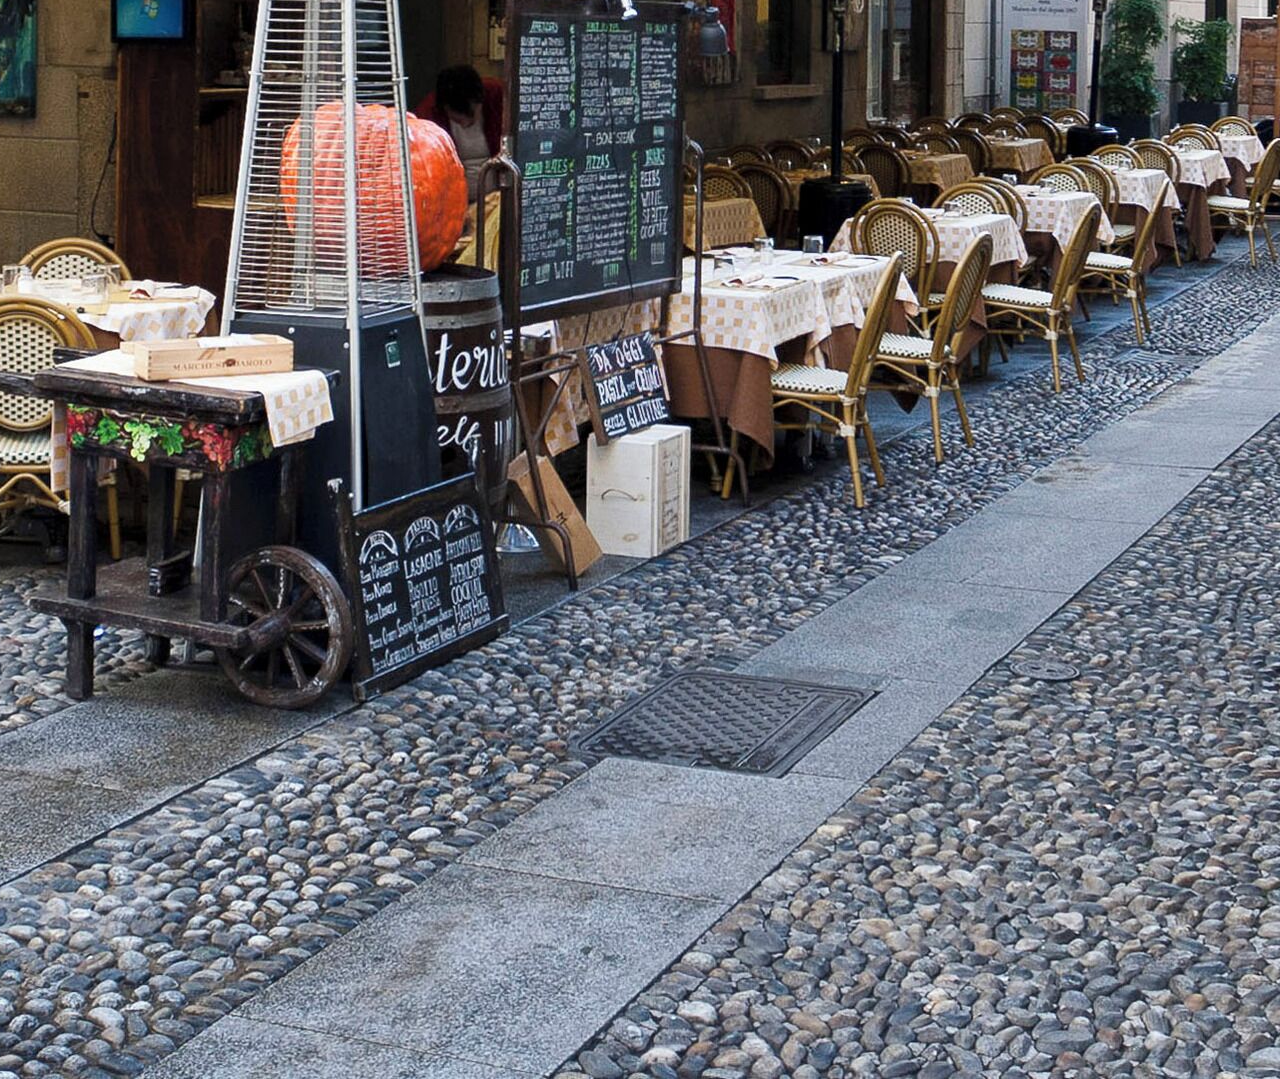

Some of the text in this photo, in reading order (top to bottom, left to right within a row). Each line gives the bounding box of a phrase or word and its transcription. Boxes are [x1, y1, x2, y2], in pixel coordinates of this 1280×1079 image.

[594, 338, 645, 373] DA OGGI
[596, 375, 628, 406] PASTA
[626, 398, 668, 429] GLUTINE
